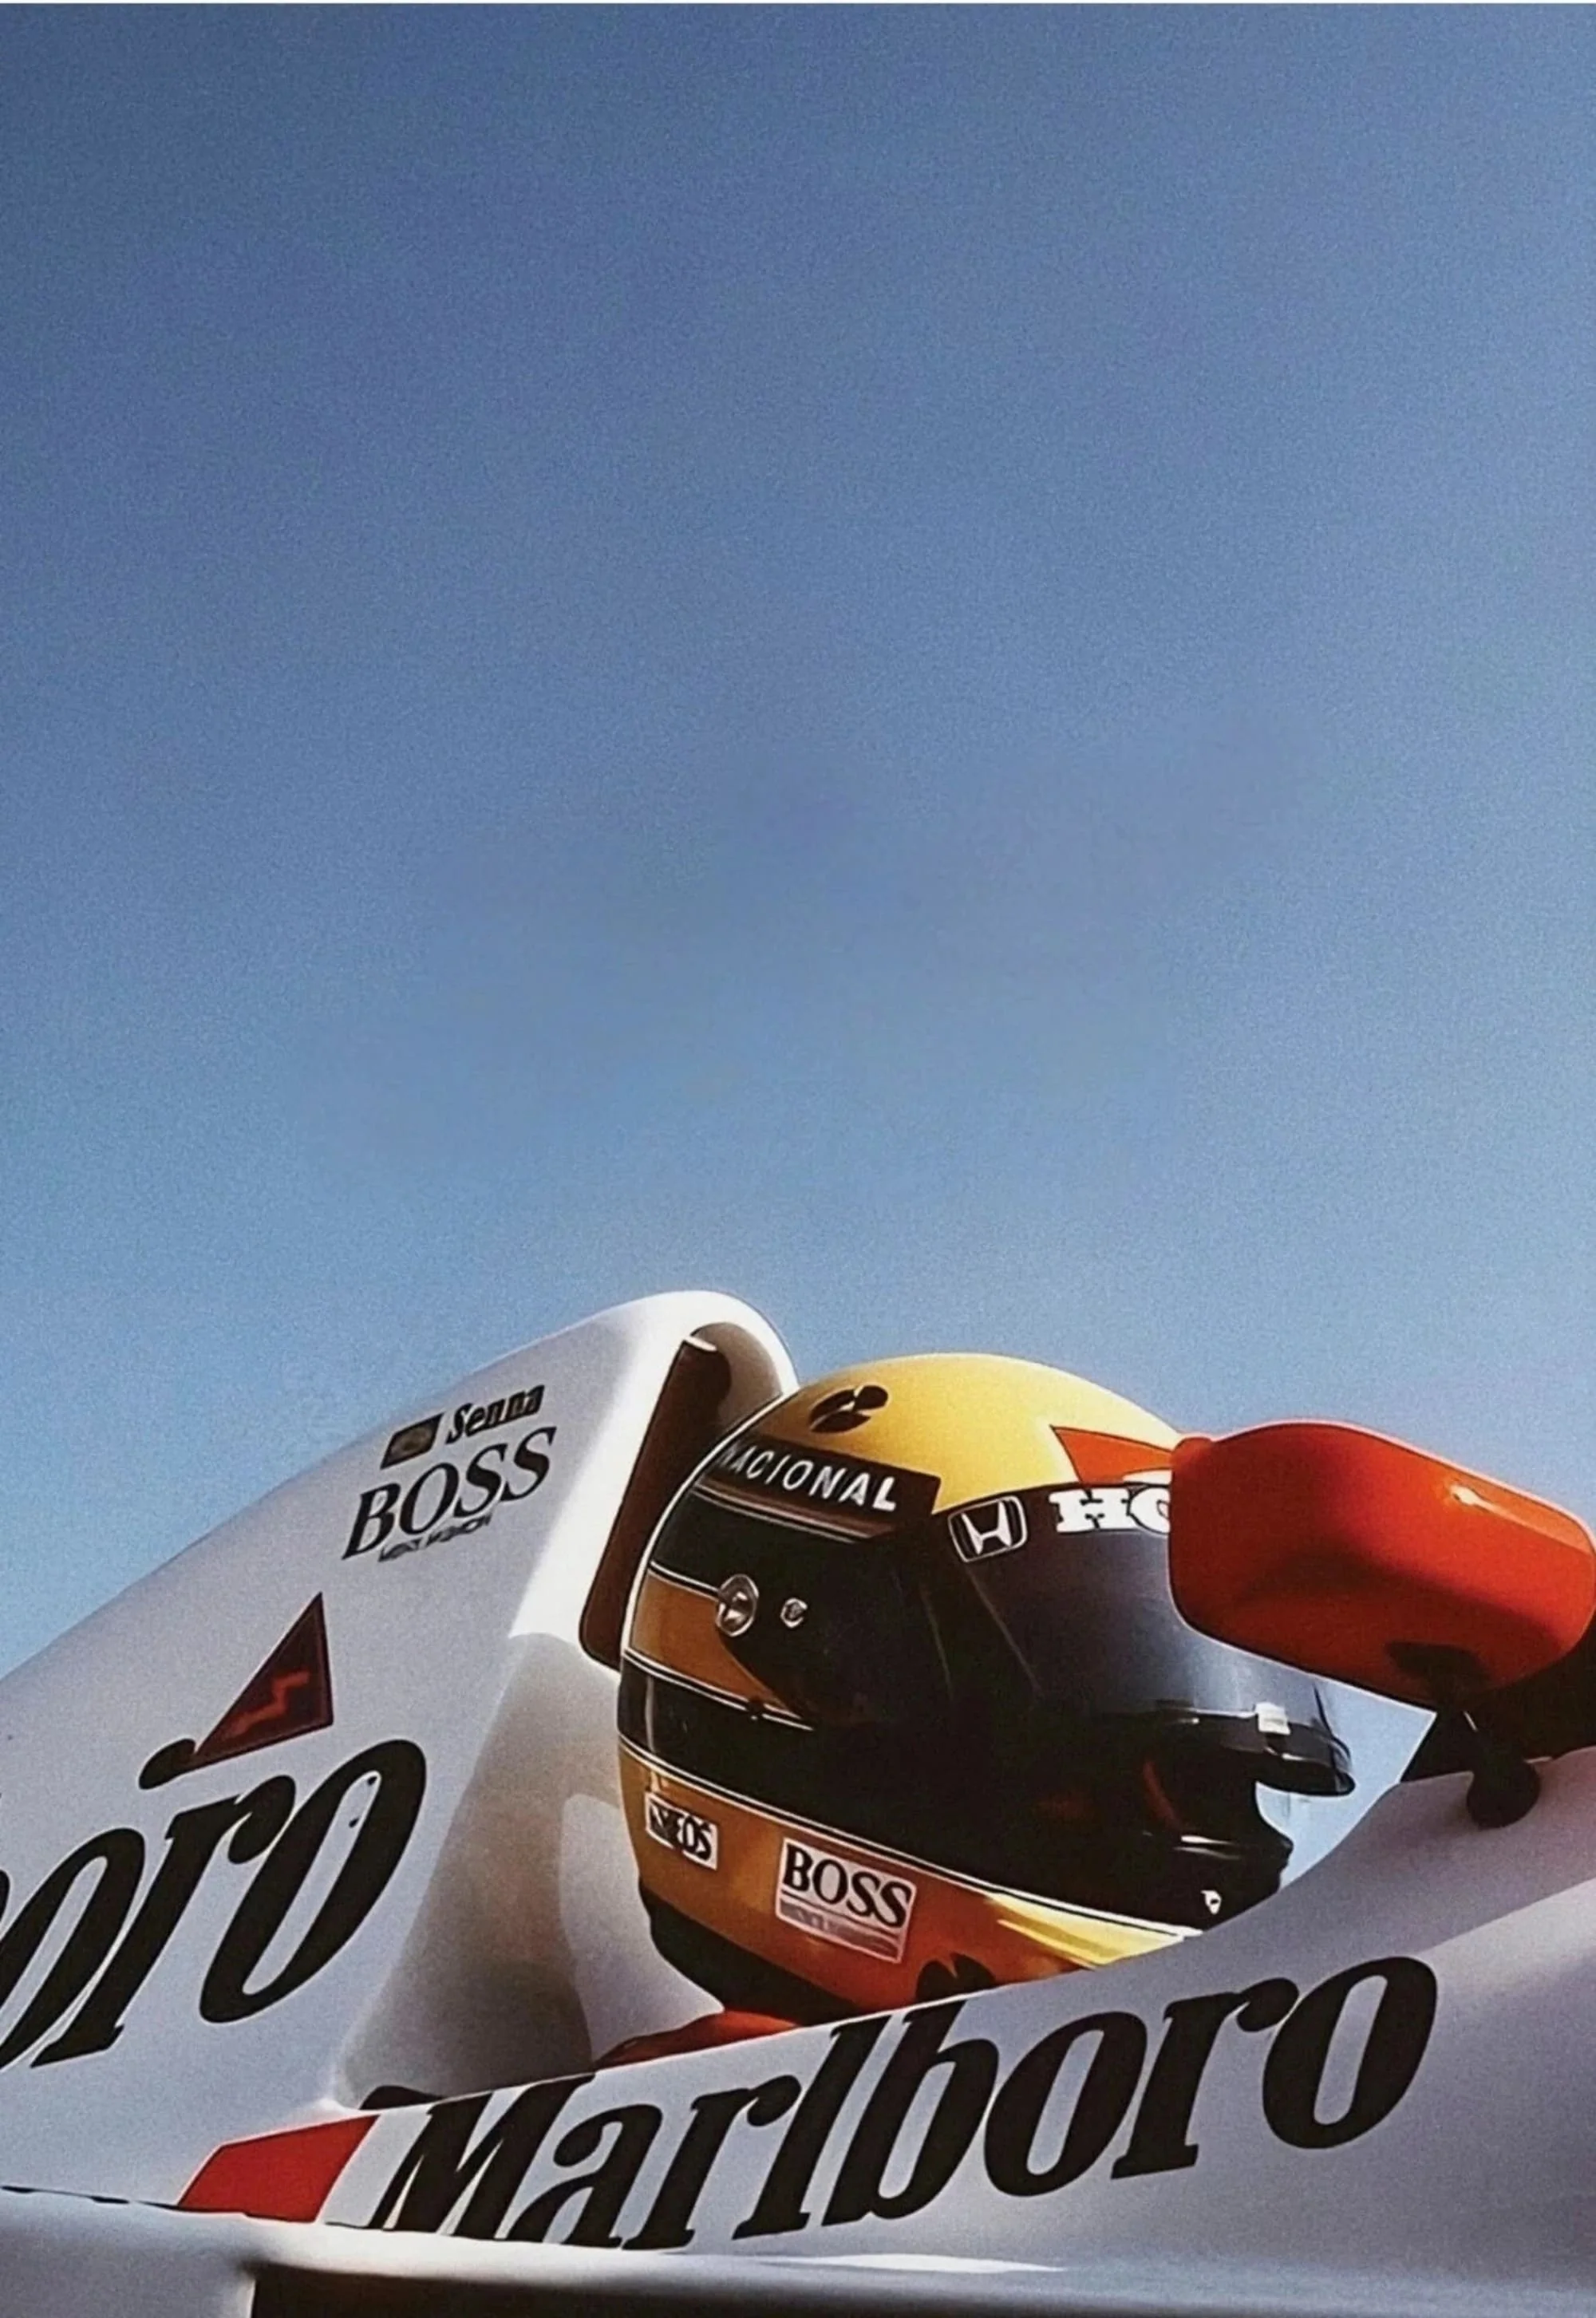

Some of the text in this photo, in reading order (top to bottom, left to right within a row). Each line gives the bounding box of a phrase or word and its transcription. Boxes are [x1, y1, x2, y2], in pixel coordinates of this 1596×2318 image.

[445, 1384, 545, 1444] Senna
[342, 1426, 557, 1560] BOSS
[782, 1843, 912, 1929] BOSS
[365, 1957, 1438, 2251] Marlboro
